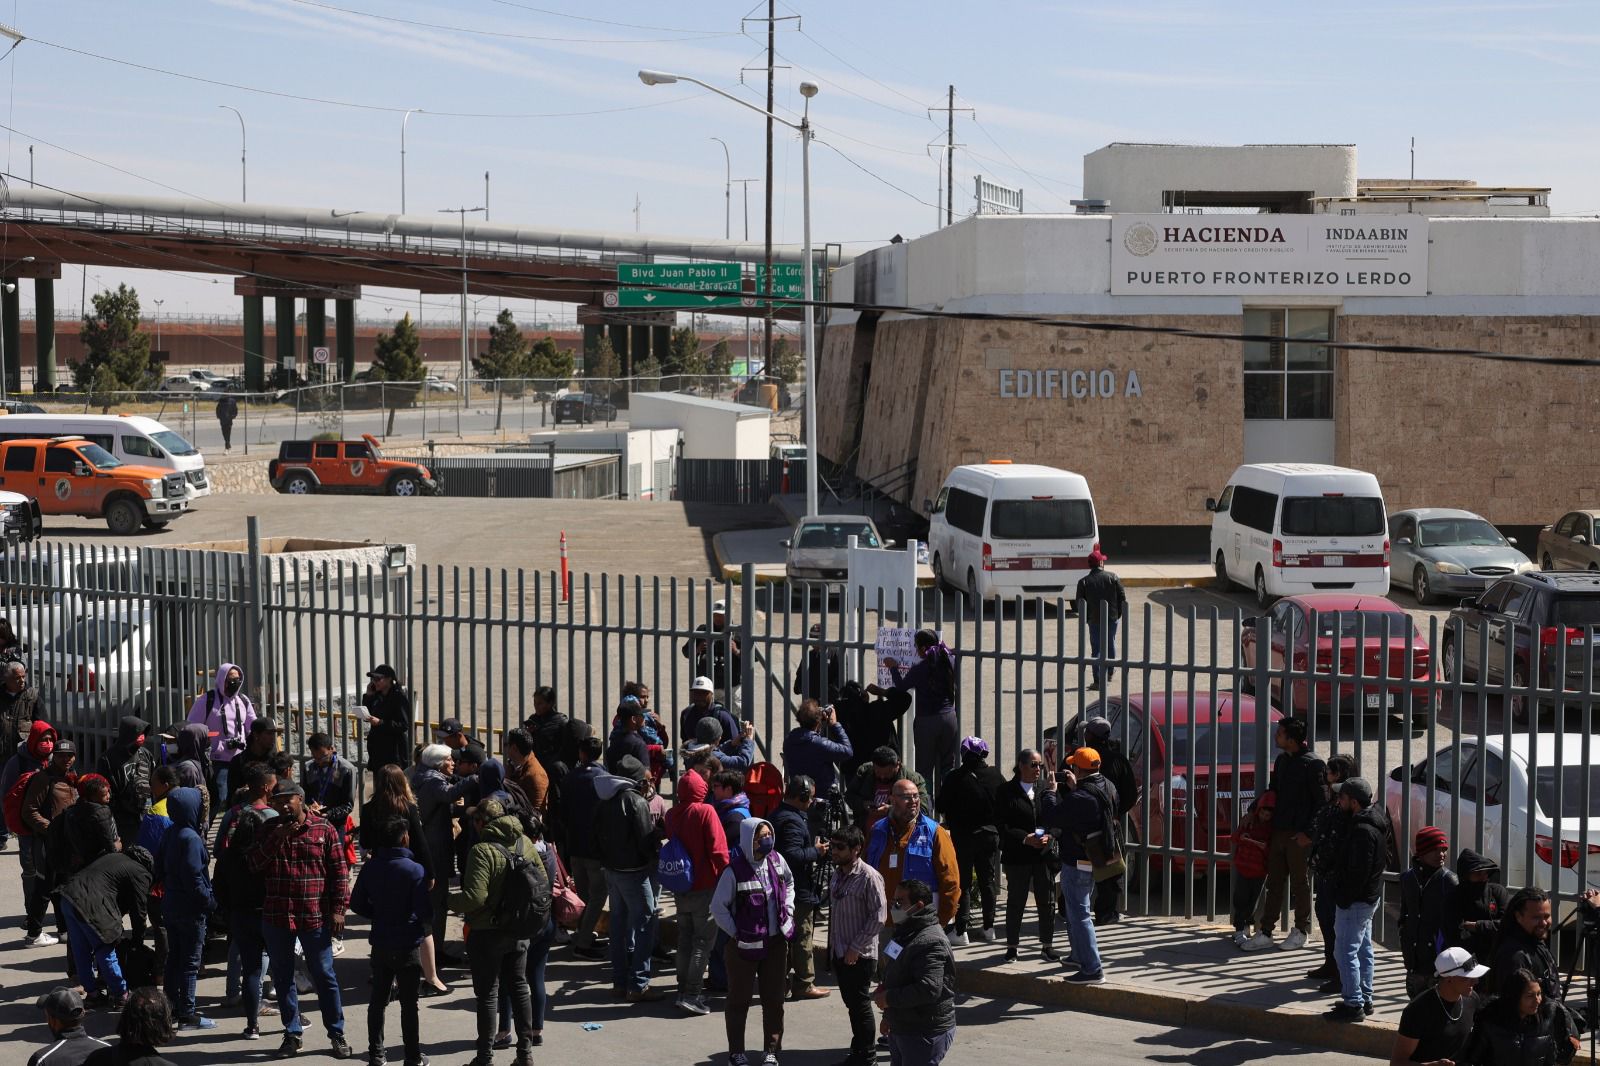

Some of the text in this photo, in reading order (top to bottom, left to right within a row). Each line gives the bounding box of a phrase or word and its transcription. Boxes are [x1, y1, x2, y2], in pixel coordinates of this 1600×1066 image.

[1163, 227, 1286, 242] HACIENDA
[1325, 228, 1408, 240] INDAABIN
[660, 268, 684, 278] Juan
[688, 268, 716, 277] Pablo
[721, 268, 727, 277] II
[1127, 271, 1412, 285] PUERTO FRONTERIZO LERDO
[1000, 369, 1143, 399] EDIFICIO A
[665, 859, 685, 872] OIM
